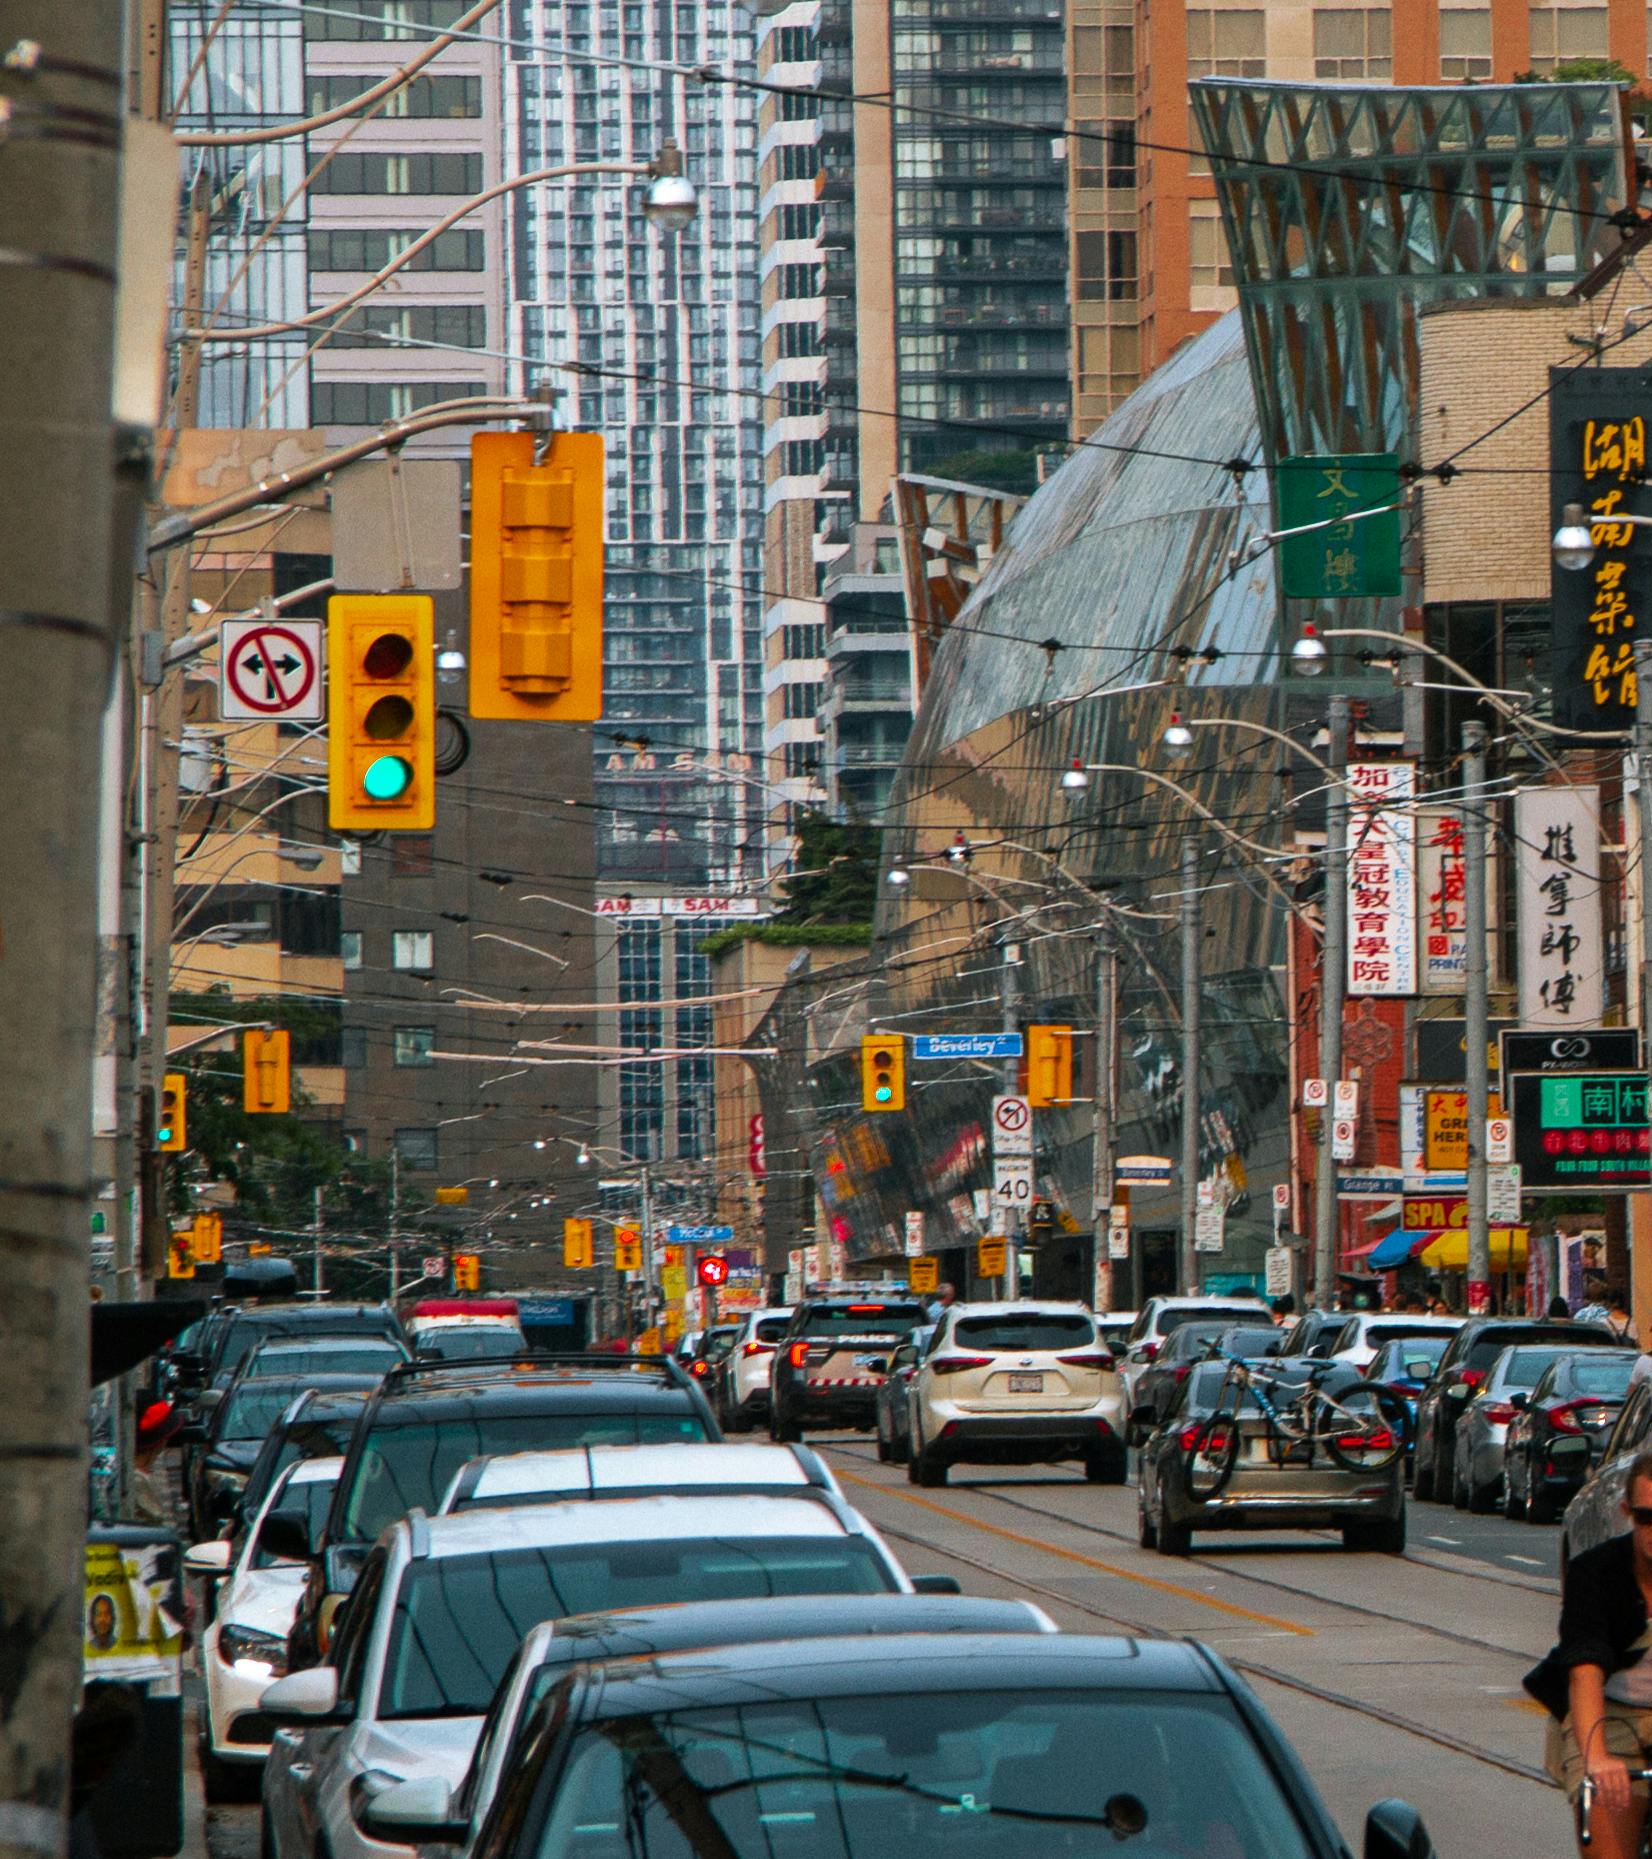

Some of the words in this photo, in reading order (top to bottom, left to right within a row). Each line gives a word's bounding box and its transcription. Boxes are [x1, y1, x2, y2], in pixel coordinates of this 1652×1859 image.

[929, 1038, 996, 1054] Beverley
[1000, 1180, 1029, 1199] 40
[1405, 1203, 1445, 1227] SPA
[838, 1334, 895, 1343] POLICE
